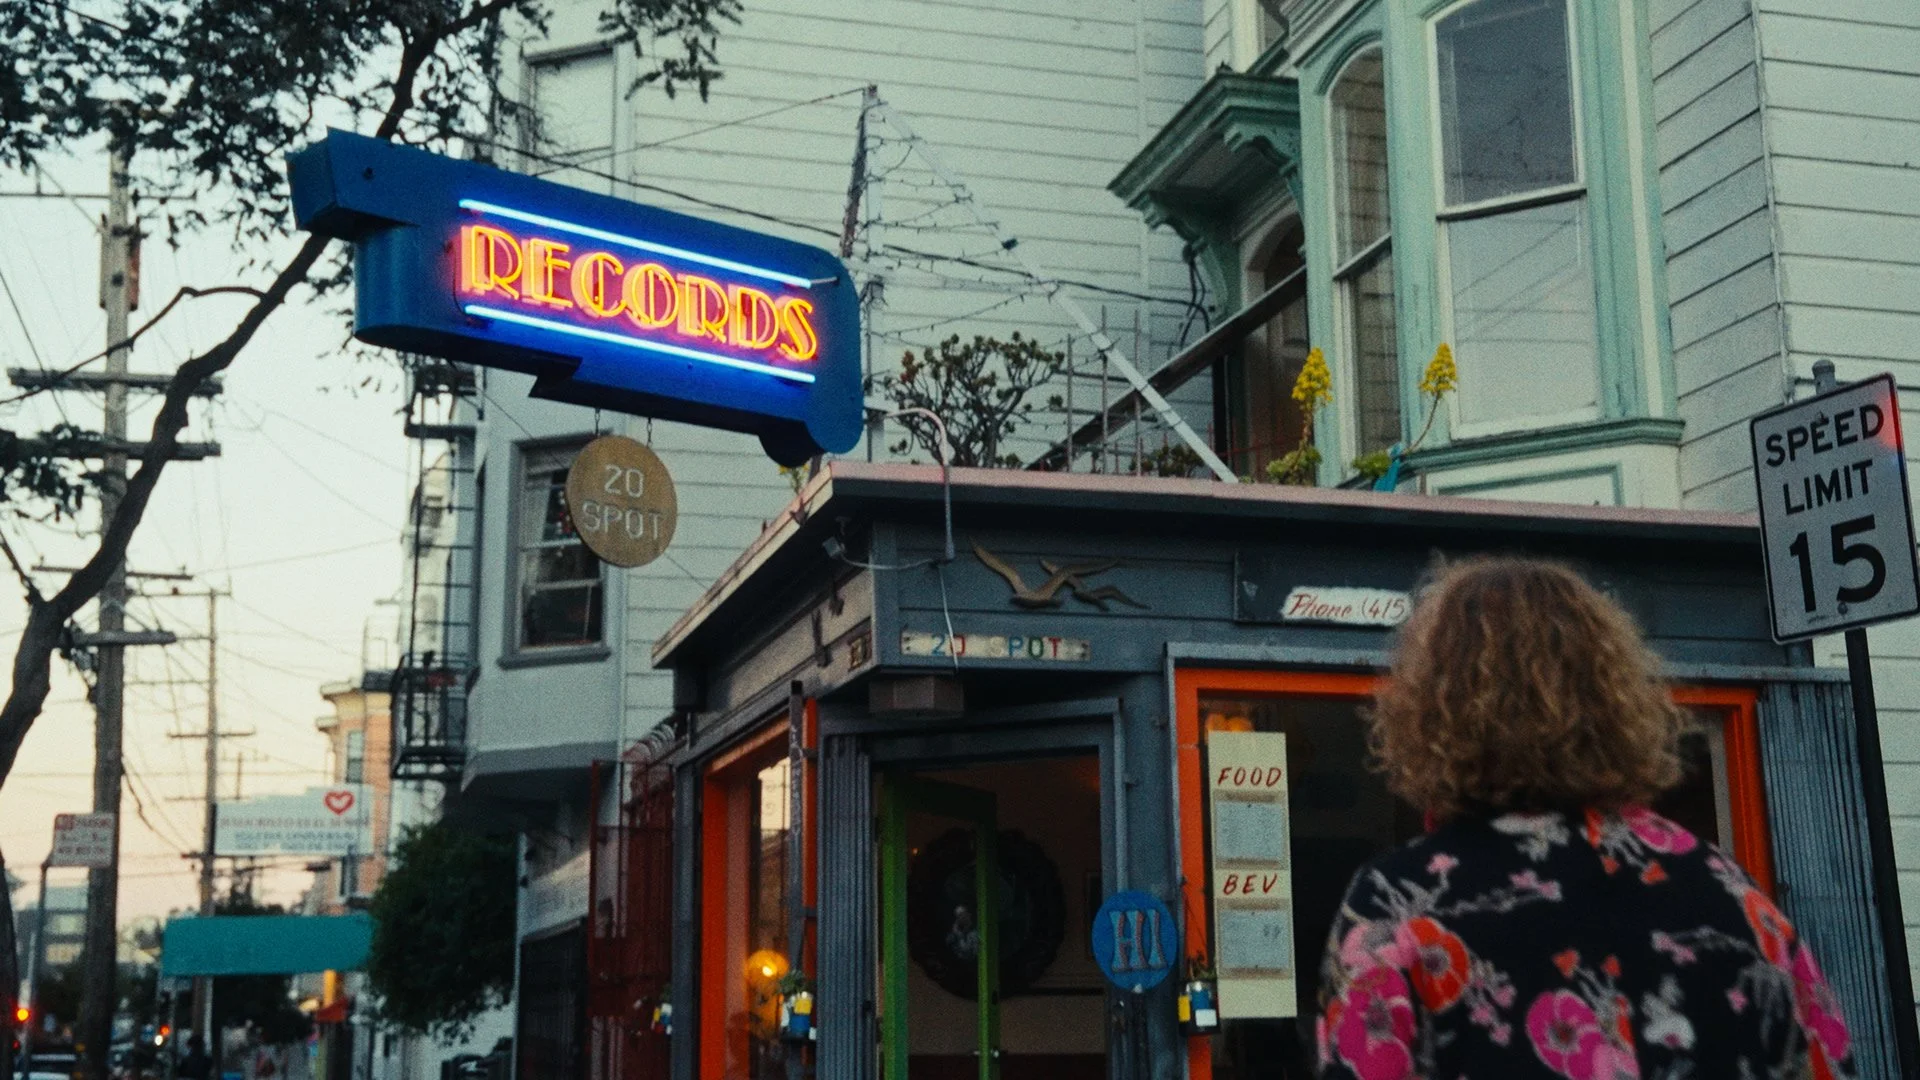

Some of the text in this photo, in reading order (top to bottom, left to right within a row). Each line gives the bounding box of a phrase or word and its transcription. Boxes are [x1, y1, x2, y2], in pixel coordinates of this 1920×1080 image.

[461, 224, 818, 361] RECORDS
[1766, 404, 1884, 467] SPEED
[604, 464, 644, 498] 20
[1783, 459, 1873, 515] LIMIT
[582, 501, 661, 540] SPOT
[1789, 514, 1886, 613] 15
[1289, 593, 1405, 619] Phone (415
[931, 633, 966, 657] 20
[1217, 767, 1282, 787] FOOD
[1223, 874, 1278, 895] BEV
[1109, 909, 1167, 971] HI
